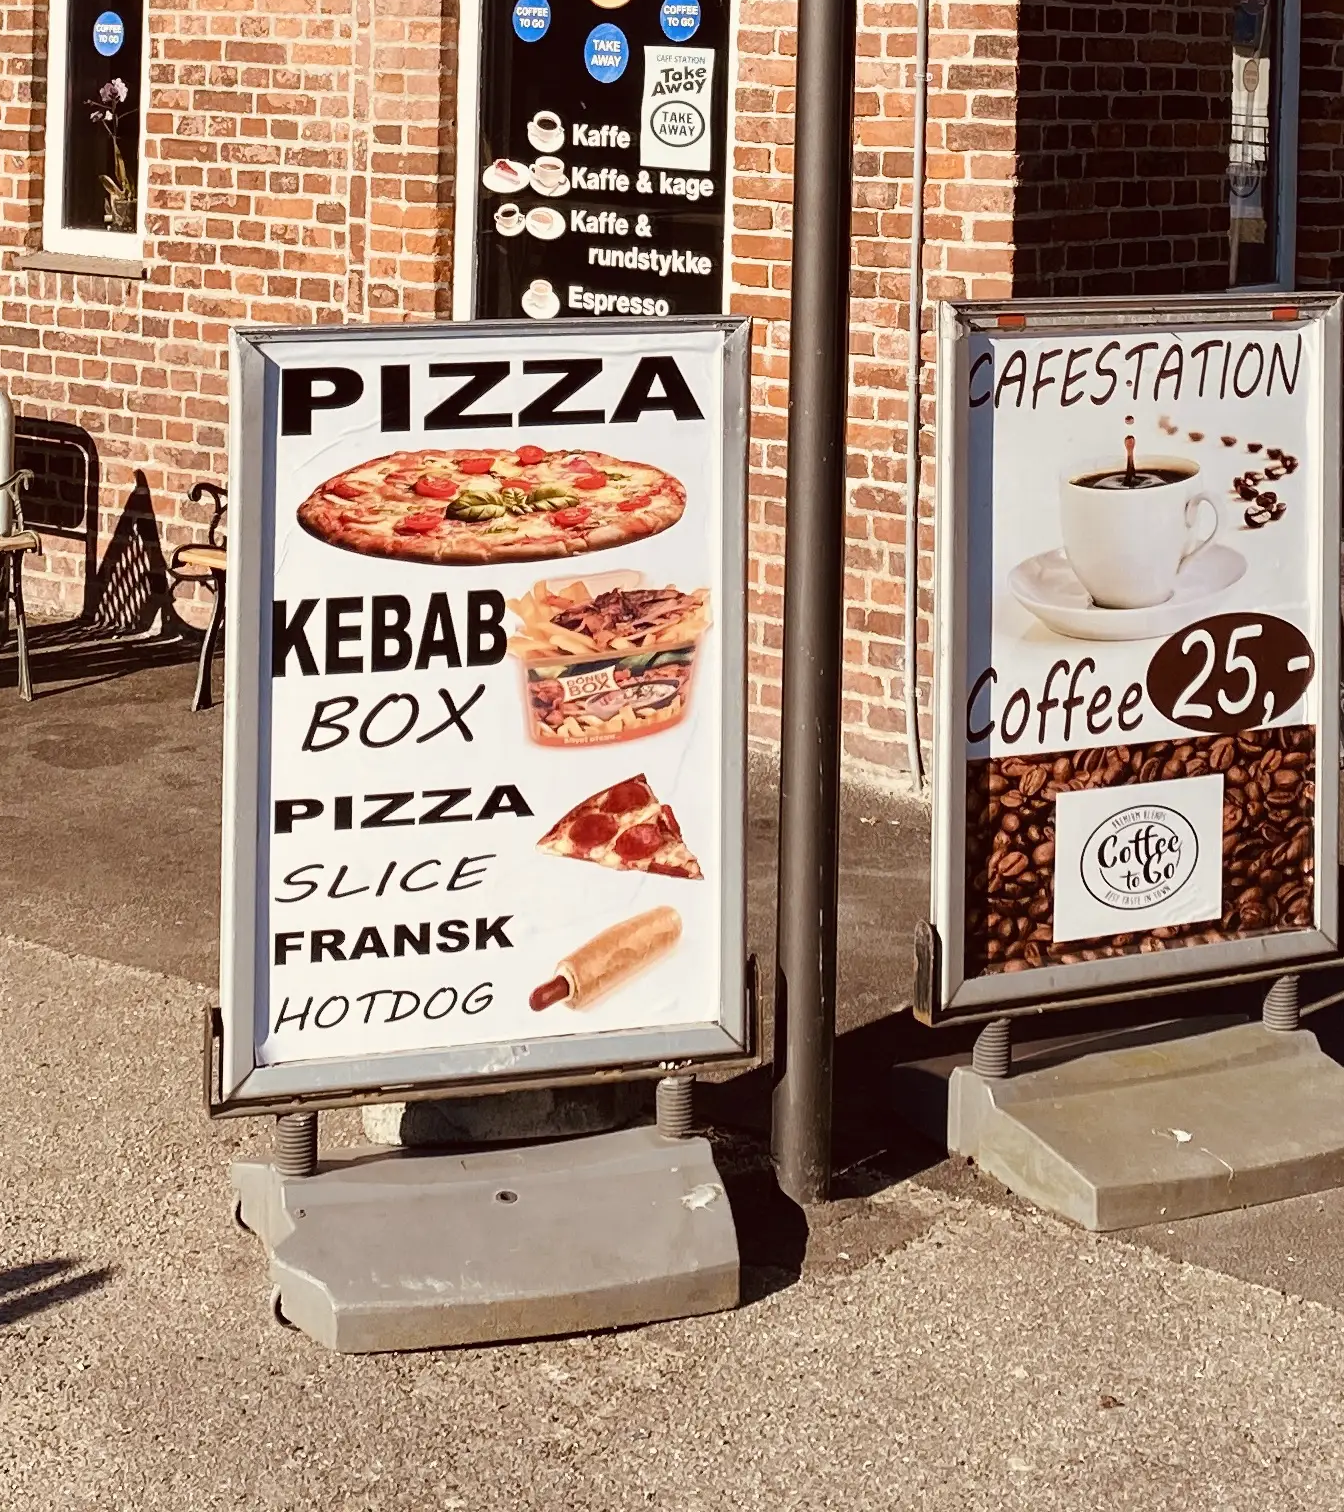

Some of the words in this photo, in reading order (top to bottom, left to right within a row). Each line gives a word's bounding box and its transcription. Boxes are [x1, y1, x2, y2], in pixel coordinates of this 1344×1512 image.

[516, 6, 549, 18] COFFEE
[519, 18, 530, 28] TO
[532, 18, 545, 29] GO
[663, 5, 699, 16] COFFEE
[667, 17, 680, 27] TO
[681, 17, 695, 28] GO
[592, 39, 621, 52] TAKE
[656, 54, 672, 63] CAFE
[674, 55, 706, 65] STATION
[590, 55, 621, 67] AWAY
[660, 66, 707, 83] Take
[651, 78, 707, 97] Away
[659, 124, 696, 137] AWAY
[662, 111, 694, 124] TAKE
[571, 124, 631, 150] Kaffe
[570, 167, 630, 194] Kaffe
[636, 171, 654, 194] &
[659, 171, 714, 202] kage
[570, 210, 630, 236] Kaffe
[635, 213, 653, 237] &
[587, 244, 713, 277] rundstykke
[568, 286, 670, 317] Espresso
[967, 333, 1305, 409] CAFESTATION
[280, 355, 705, 436] PIZZA
[271, 588, 507, 680] KEBAB
[1172, 622, 1311, 724] 25,-
[568, 679, 612, 697] BOX
[965, 656, 1145, 744] Coffee
[301, 683, 485, 753] BOX
[273, 783, 535, 835] PIZZA
[1097, 825, 1179, 869] Coffee
[275, 853, 497, 904] SLICE
[1120, 870, 1140, 891] to
[1143, 853, 1175, 885] Go
[1144, 894, 1152, 903] IN
[273, 914, 515, 967] FRANSK
[273, 981, 495, 1035] HOTDOG
